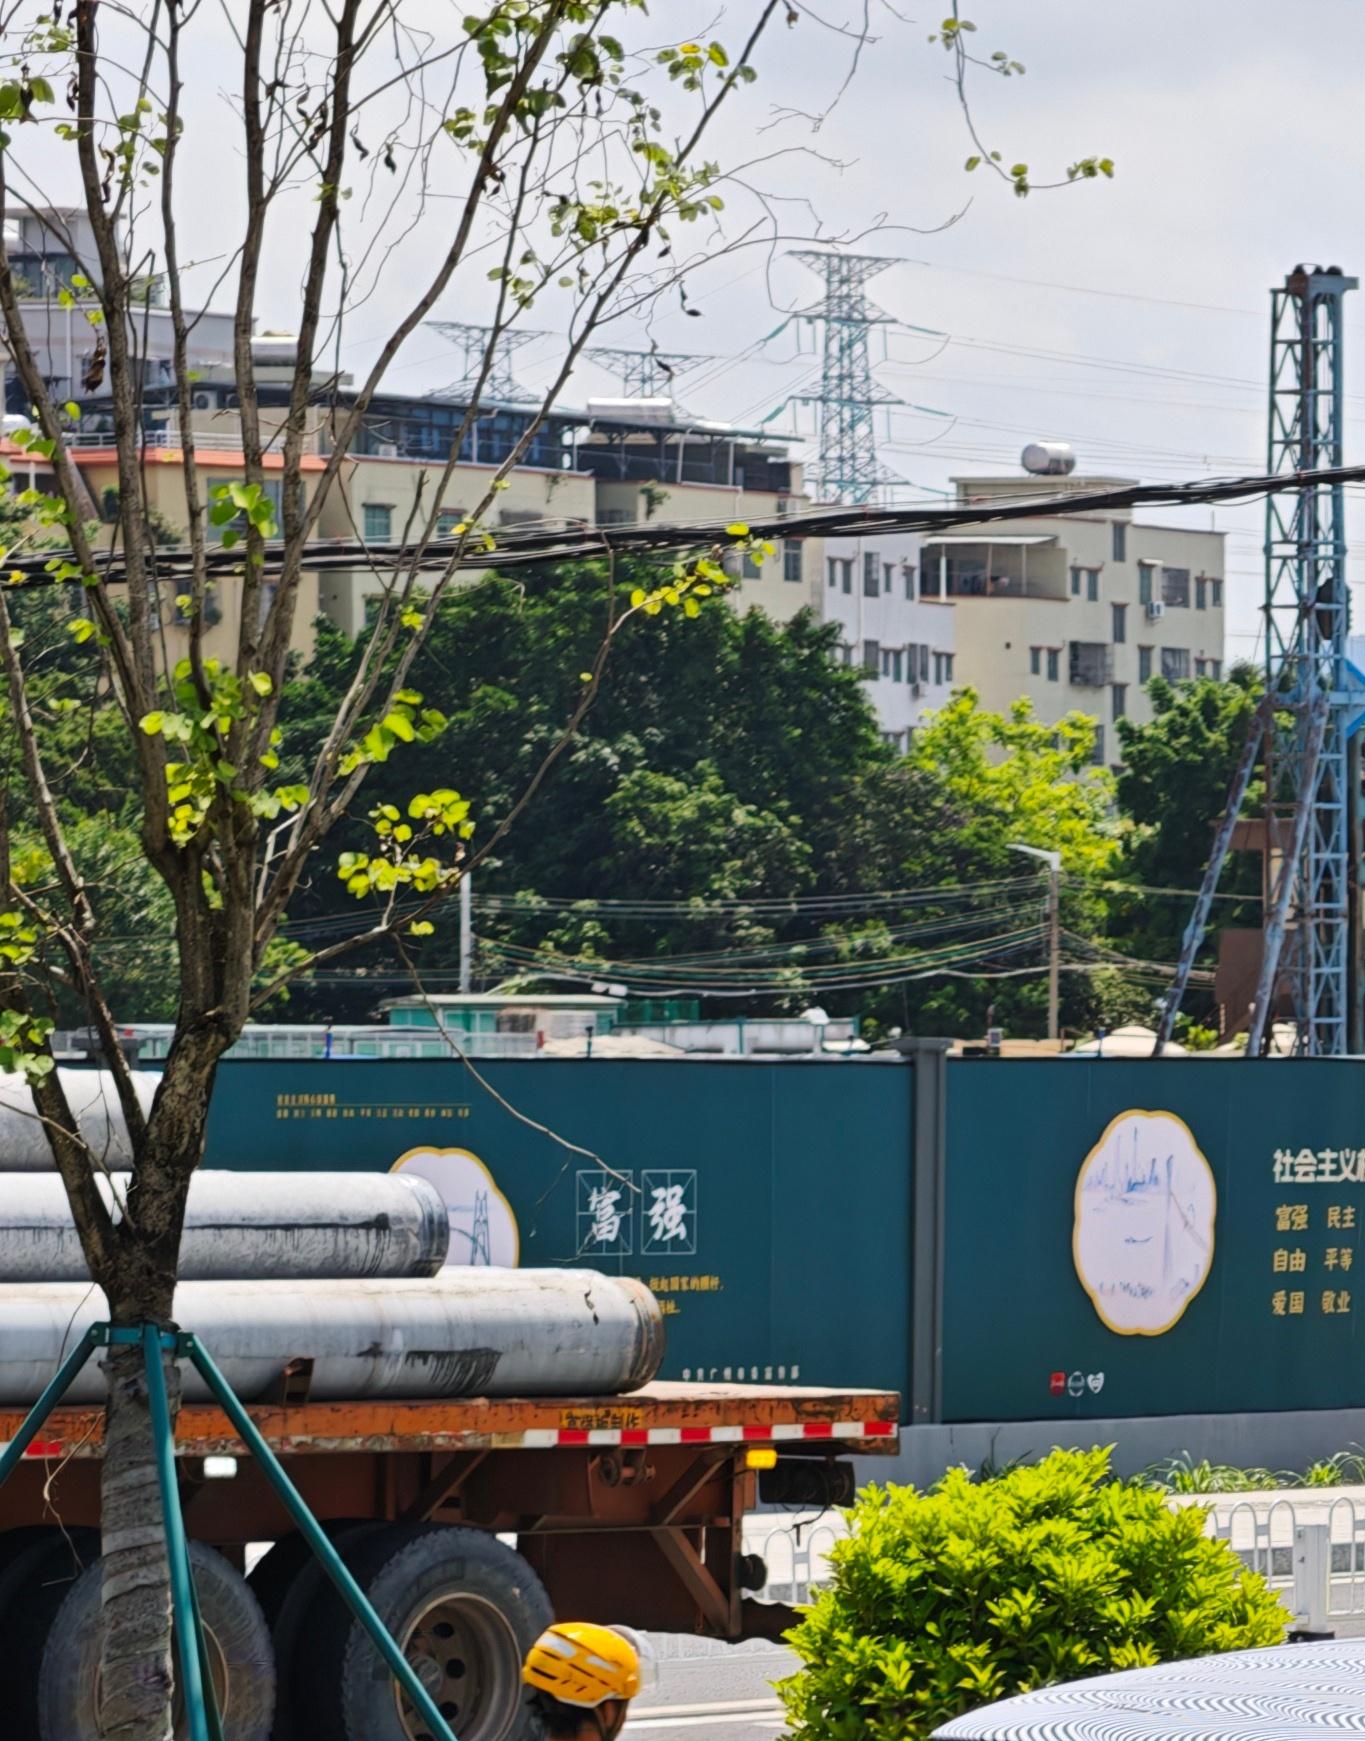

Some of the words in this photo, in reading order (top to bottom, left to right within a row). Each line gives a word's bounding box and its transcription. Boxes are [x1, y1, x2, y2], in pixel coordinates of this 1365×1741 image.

[587, 1184, 688, 1242] 富强
[1275, 1203, 1309, 1232] 富强
[1327, 1205, 1356, 1229] 民主
[1273, 1248, 1307, 1273] 自由
[1323, 1248, 1353, 1272] 平等
[1271, 1289, 1305, 1316] 爱国
[1321, 1290, 1351, 1314] 敬业
